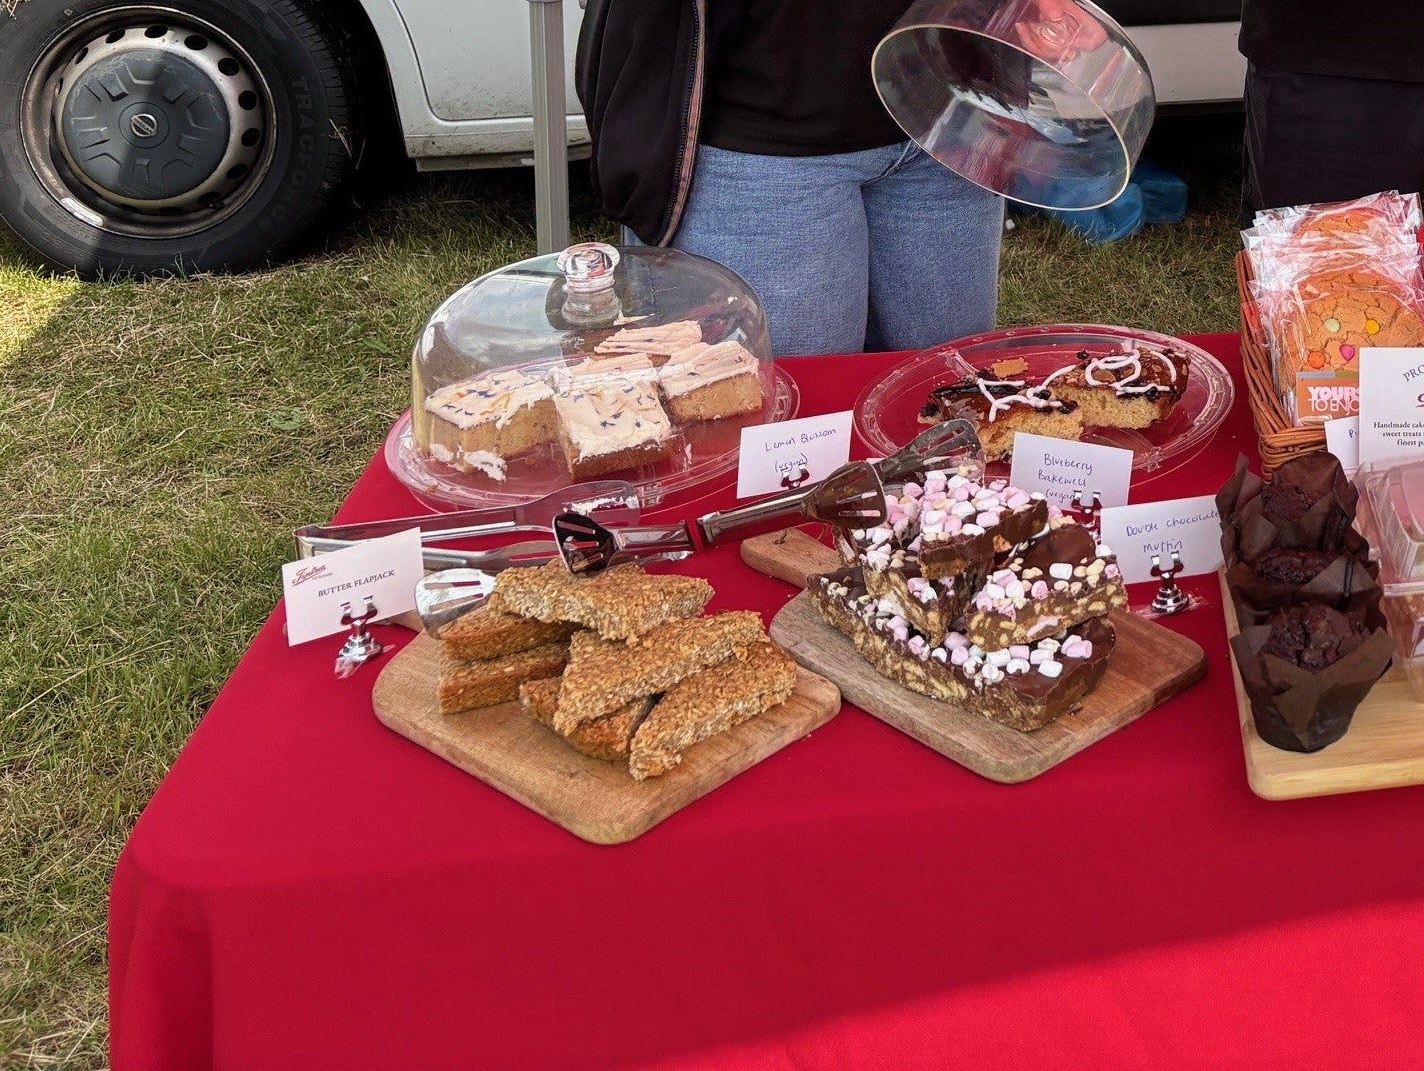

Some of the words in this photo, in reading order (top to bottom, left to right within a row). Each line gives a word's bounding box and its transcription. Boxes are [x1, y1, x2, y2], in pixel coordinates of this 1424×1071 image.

[1308, 399, 1328, 412] TO
[765, 437, 796, 452] Lemon
[1397, 438, 1417, 446] finest
[1044, 452, 1093, 476] Blueberry
[1038, 469, 1087, 487] Bakewell
[1126, 521, 1159, 537] Double
[1143, 538, 1183, 552] muffin
[317, 582, 352, 597] BUTTER
[353, 569, 396, 588] FLAPJACK
